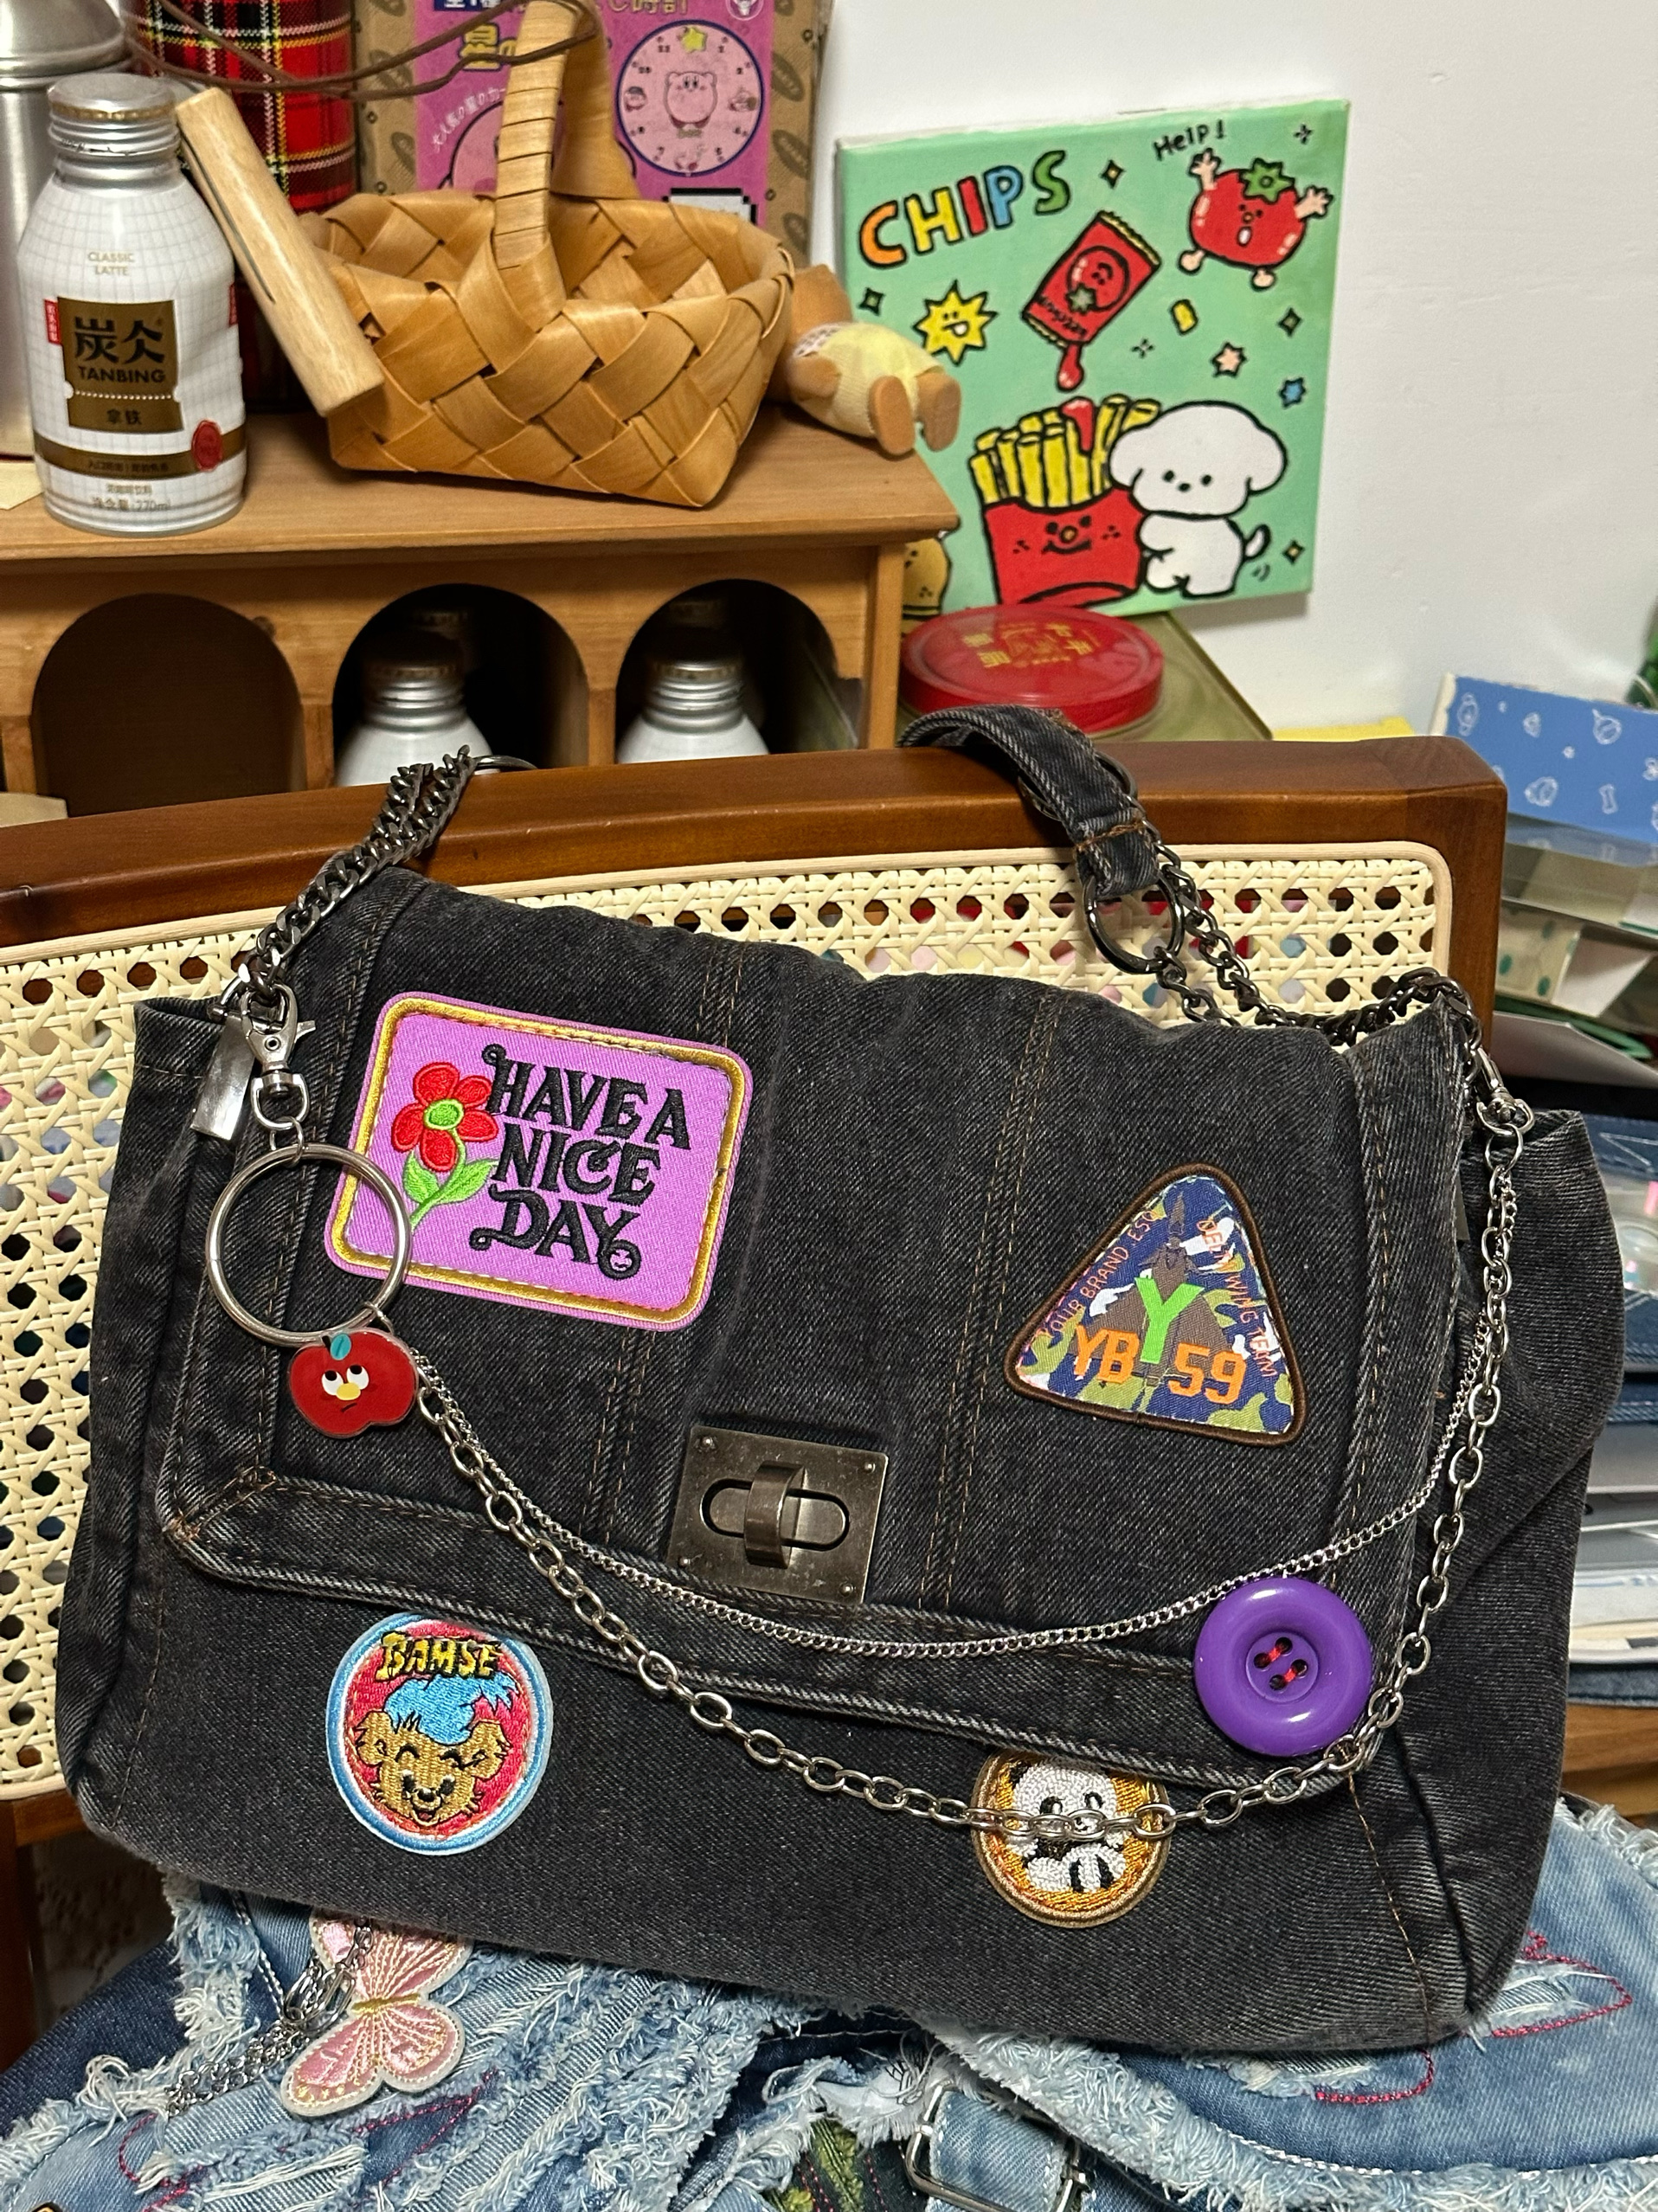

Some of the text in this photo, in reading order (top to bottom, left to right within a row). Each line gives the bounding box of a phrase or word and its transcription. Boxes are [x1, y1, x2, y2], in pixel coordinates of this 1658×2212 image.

[858, 149, 1070, 267] CHIPS
[87, 251, 136, 263] CLASSIC
[94, 265, 129, 276] LATTE
[78, 365, 167, 384] TANBING
[482, 1044, 691, 1150] HAVE A
[491, 1123, 661, 1206] NICE
[469, 1182, 642, 1280] DAY
[1080, 1246, 1129, 1299] BRAND
[1134, 1276, 1205, 1365] Y
[1224, 1274, 1259, 1324] WING
[1248, 1326, 1278, 1378] TEAM
[1074, 1324, 1247, 1405] YB 59
[374, 1630, 502, 1682] BAMSE
